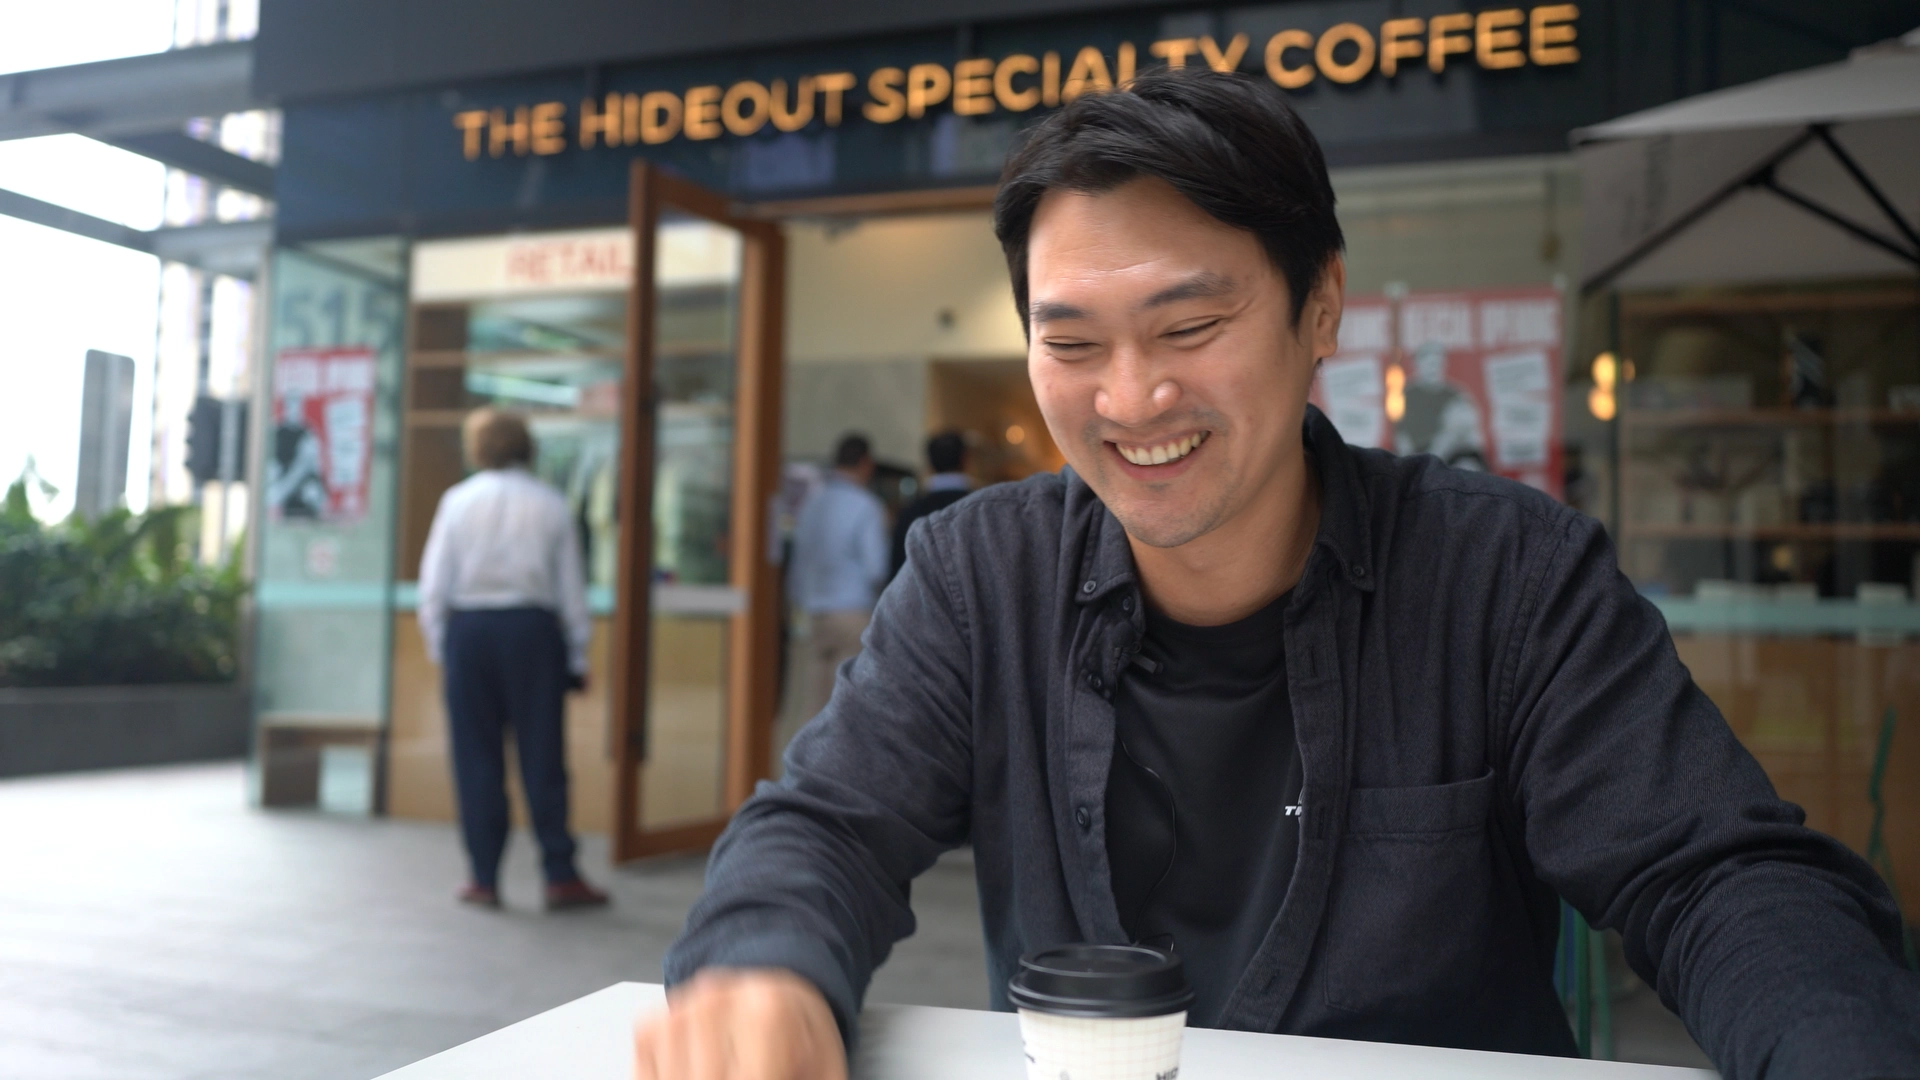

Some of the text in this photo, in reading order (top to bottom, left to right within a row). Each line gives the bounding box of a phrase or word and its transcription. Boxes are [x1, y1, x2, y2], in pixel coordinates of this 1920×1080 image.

[454, 102, 566, 161] THE
[578, 72, 857, 151] HIDEOUT
[1264, 4, 1581, 89] COFFEE
[505, 241, 634, 285] RETAIL
